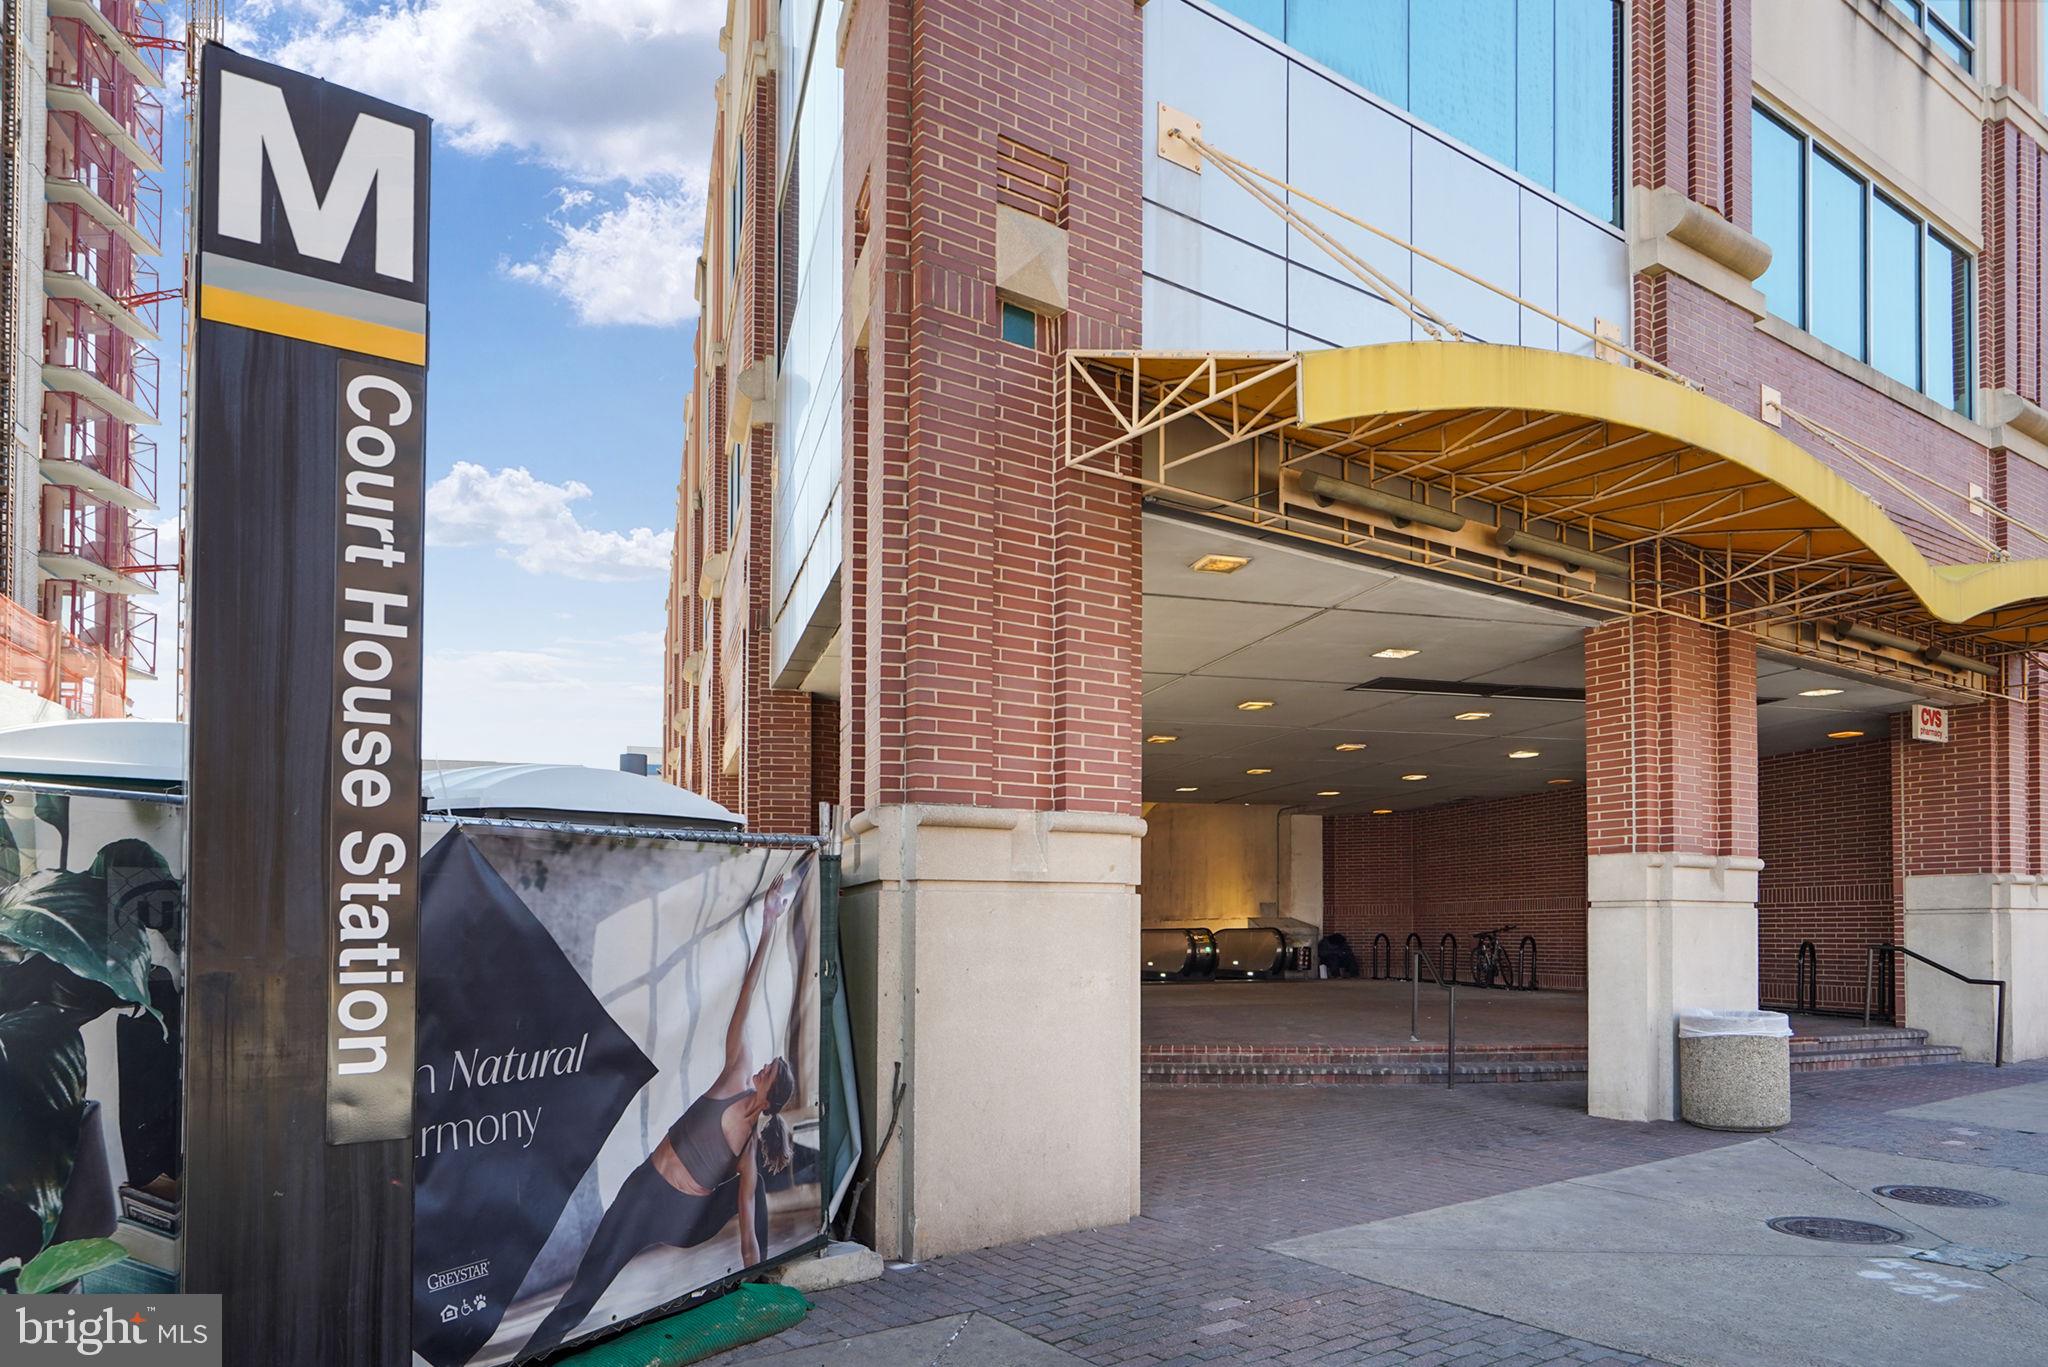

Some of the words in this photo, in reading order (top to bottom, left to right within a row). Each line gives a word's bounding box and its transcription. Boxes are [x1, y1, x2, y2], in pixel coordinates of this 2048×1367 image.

[218, 69, 415, 283] M
[345, 374, 413, 568] Court
[341, 587, 408, 808] House
[1921, 707, 1942, 728] CVS
[1920, 727, 1943, 739] pharmacy
[337, 831, 407, 1076] Station
[449, 1032, 589, 1092] Natural
[415, 1106, 542, 1159] rmony
[427, 1261, 489, 1290] GREYSTAR
